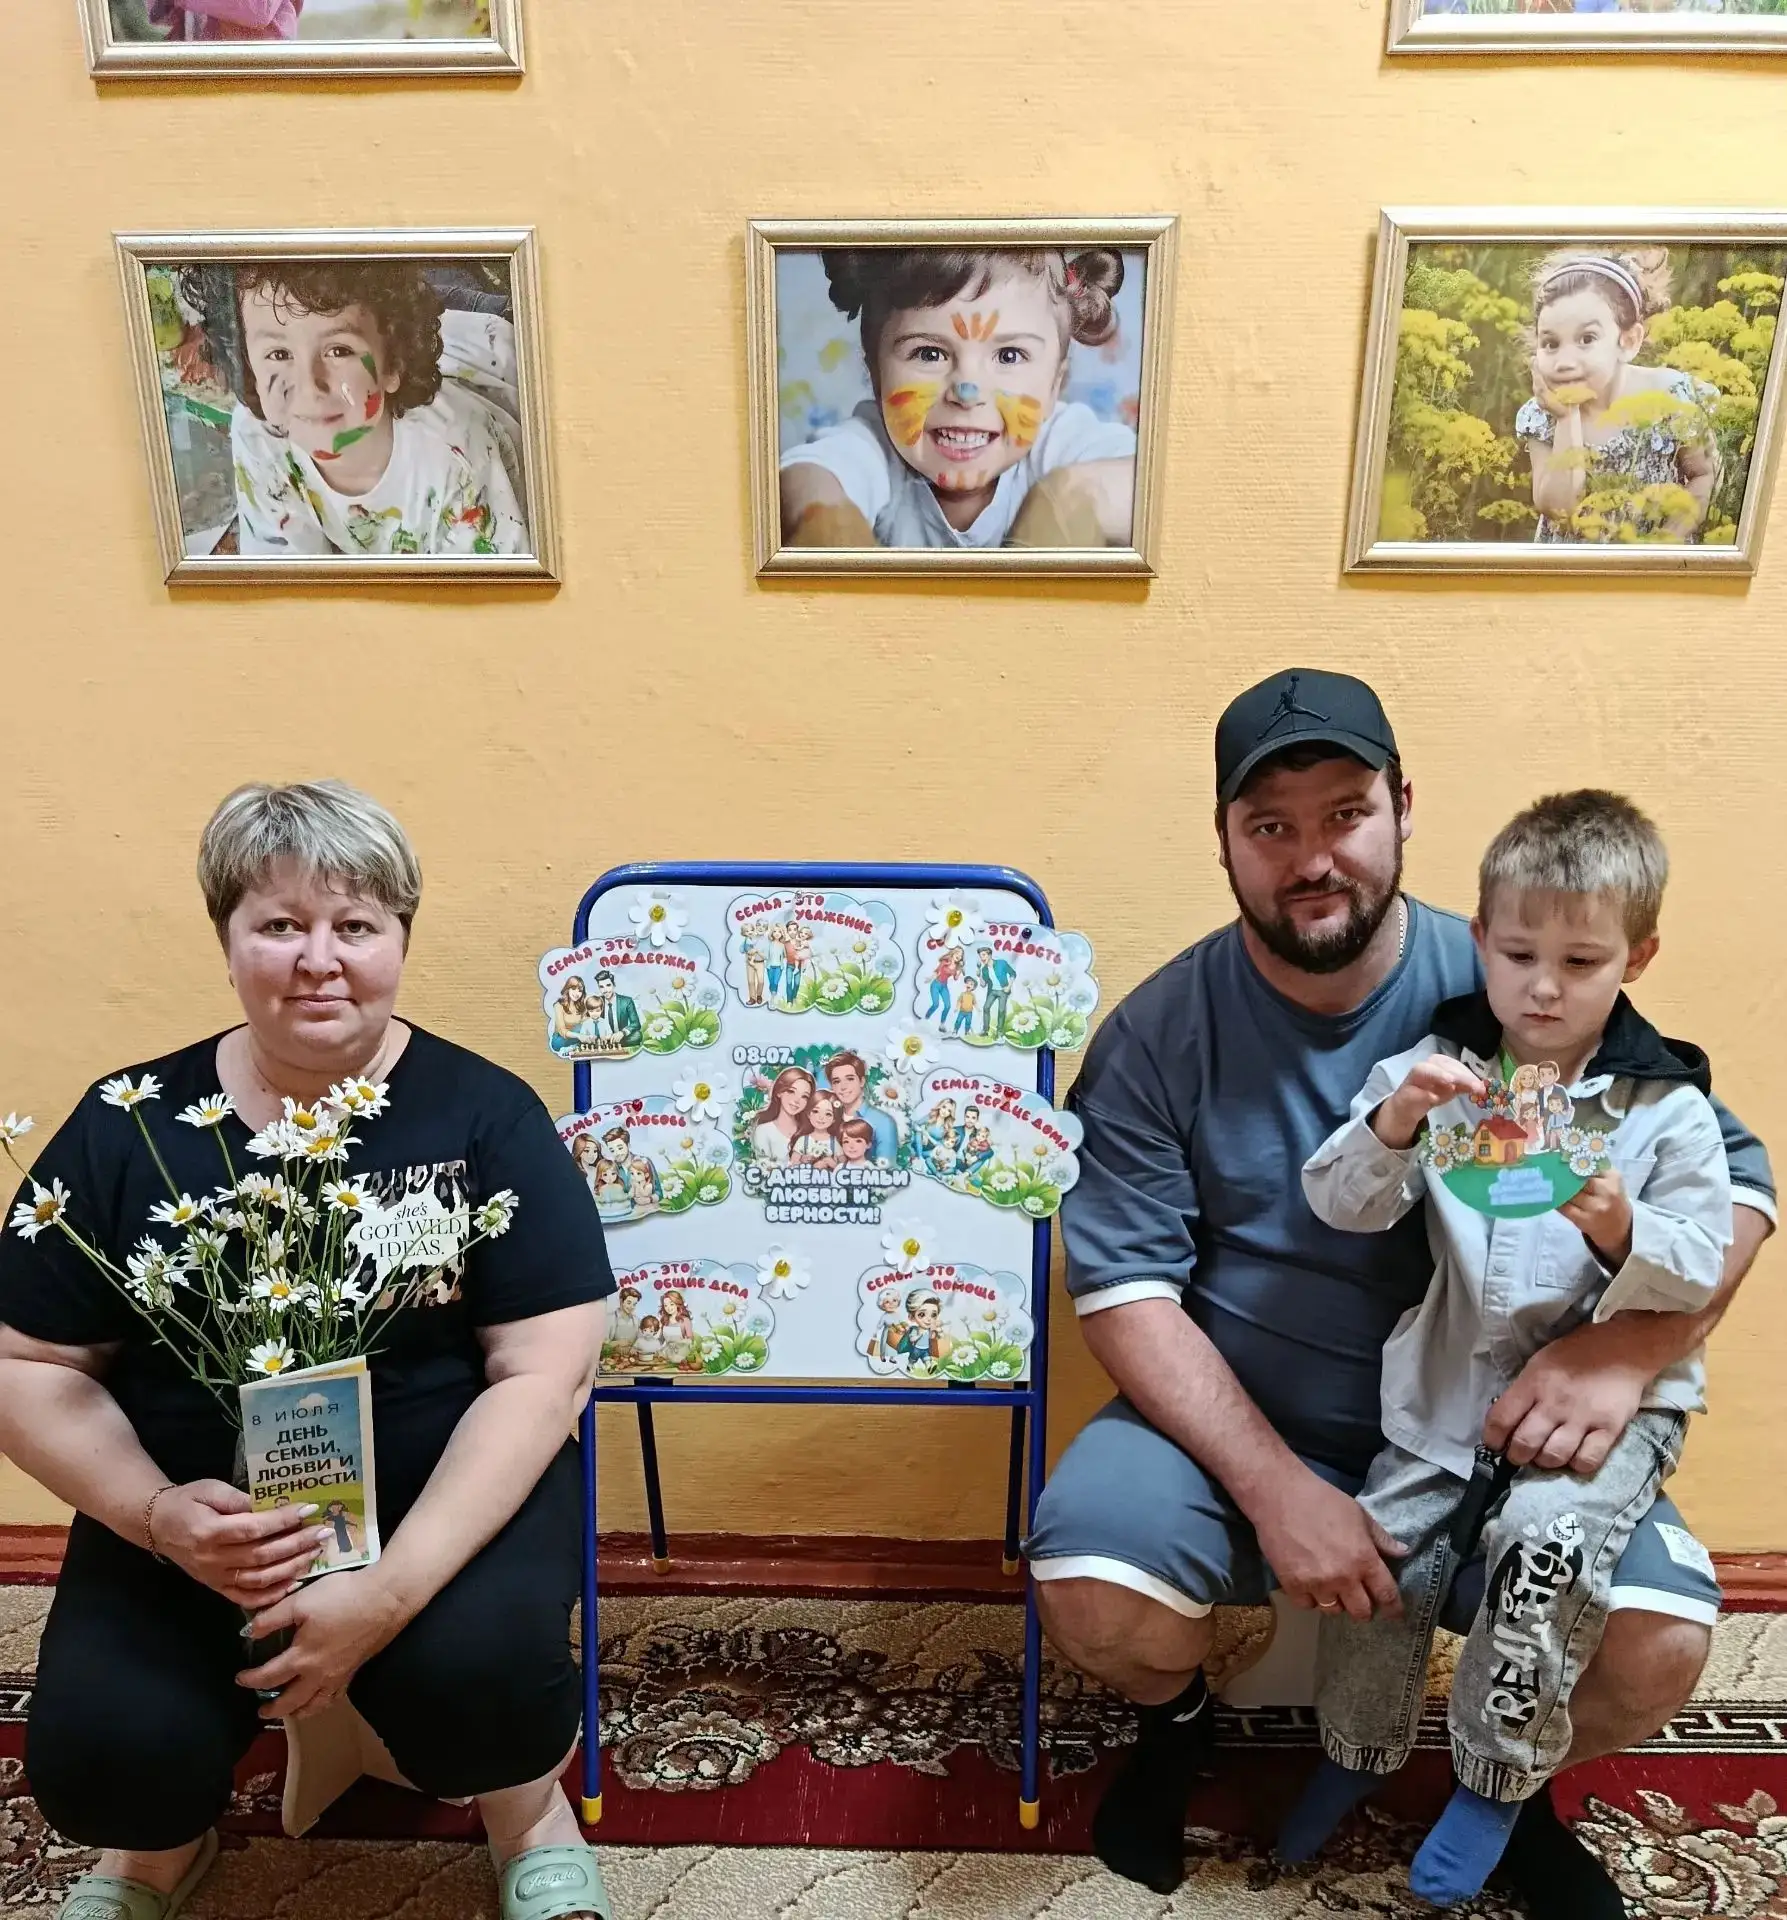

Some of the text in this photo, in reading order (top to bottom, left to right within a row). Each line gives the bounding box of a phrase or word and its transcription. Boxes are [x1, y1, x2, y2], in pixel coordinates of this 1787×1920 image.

[735, 898, 782, 921] СЕМЬЯ
[795, 909, 873, 934] УВАЖЕНИЕ
[988, 924, 1019, 937] ЭТО
[547, 946, 592, 976] СЕМЬЯ
[600, 952, 696, 972] ПОДДЕРЖКА
[994, 940, 1062, 964] РАДОСТЬ
[733, 1045, 796, 1065] 08.07.
[932, 1079, 980, 1091] СЕМЬЯ
[626, 1115, 687, 1128] ЛЮБОВЬ
[975, 1094, 1070, 1151] СЕРДЦЕ ДОМА
[745, 1164, 910, 1187] С ДНЁМ СЕМЬИ
[770, 1187, 869, 1204] ЛЮБВИ И
[394, 1201, 428, 1221] she's
[766, 1206, 881, 1224] ВЕРНОСТИ!
[360, 1218, 462, 1241] GOT WILD
[380, 1239, 445, 1258] IDEAS.
[661, 1263, 690, 1275] ЭТО
[926, 1265, 955, 1276] ЭТО
[654, 1278, 749, 1299] ОБЩИЕ ДЕЛА
[932, 1279, 996, 1301] ПОМОЩЬ
[252, 1403, 339, 1425] 8 ИЮЛЯ
[276, 1424, 328, 1446] ДЕНЬ
[265, 1440, 341, 1463] СЕМЬИ,
[256, 1455, 354, 1483] ЛЮБВИ И
[254, 1470, 357, 1501] ВЕРНОСТИ
